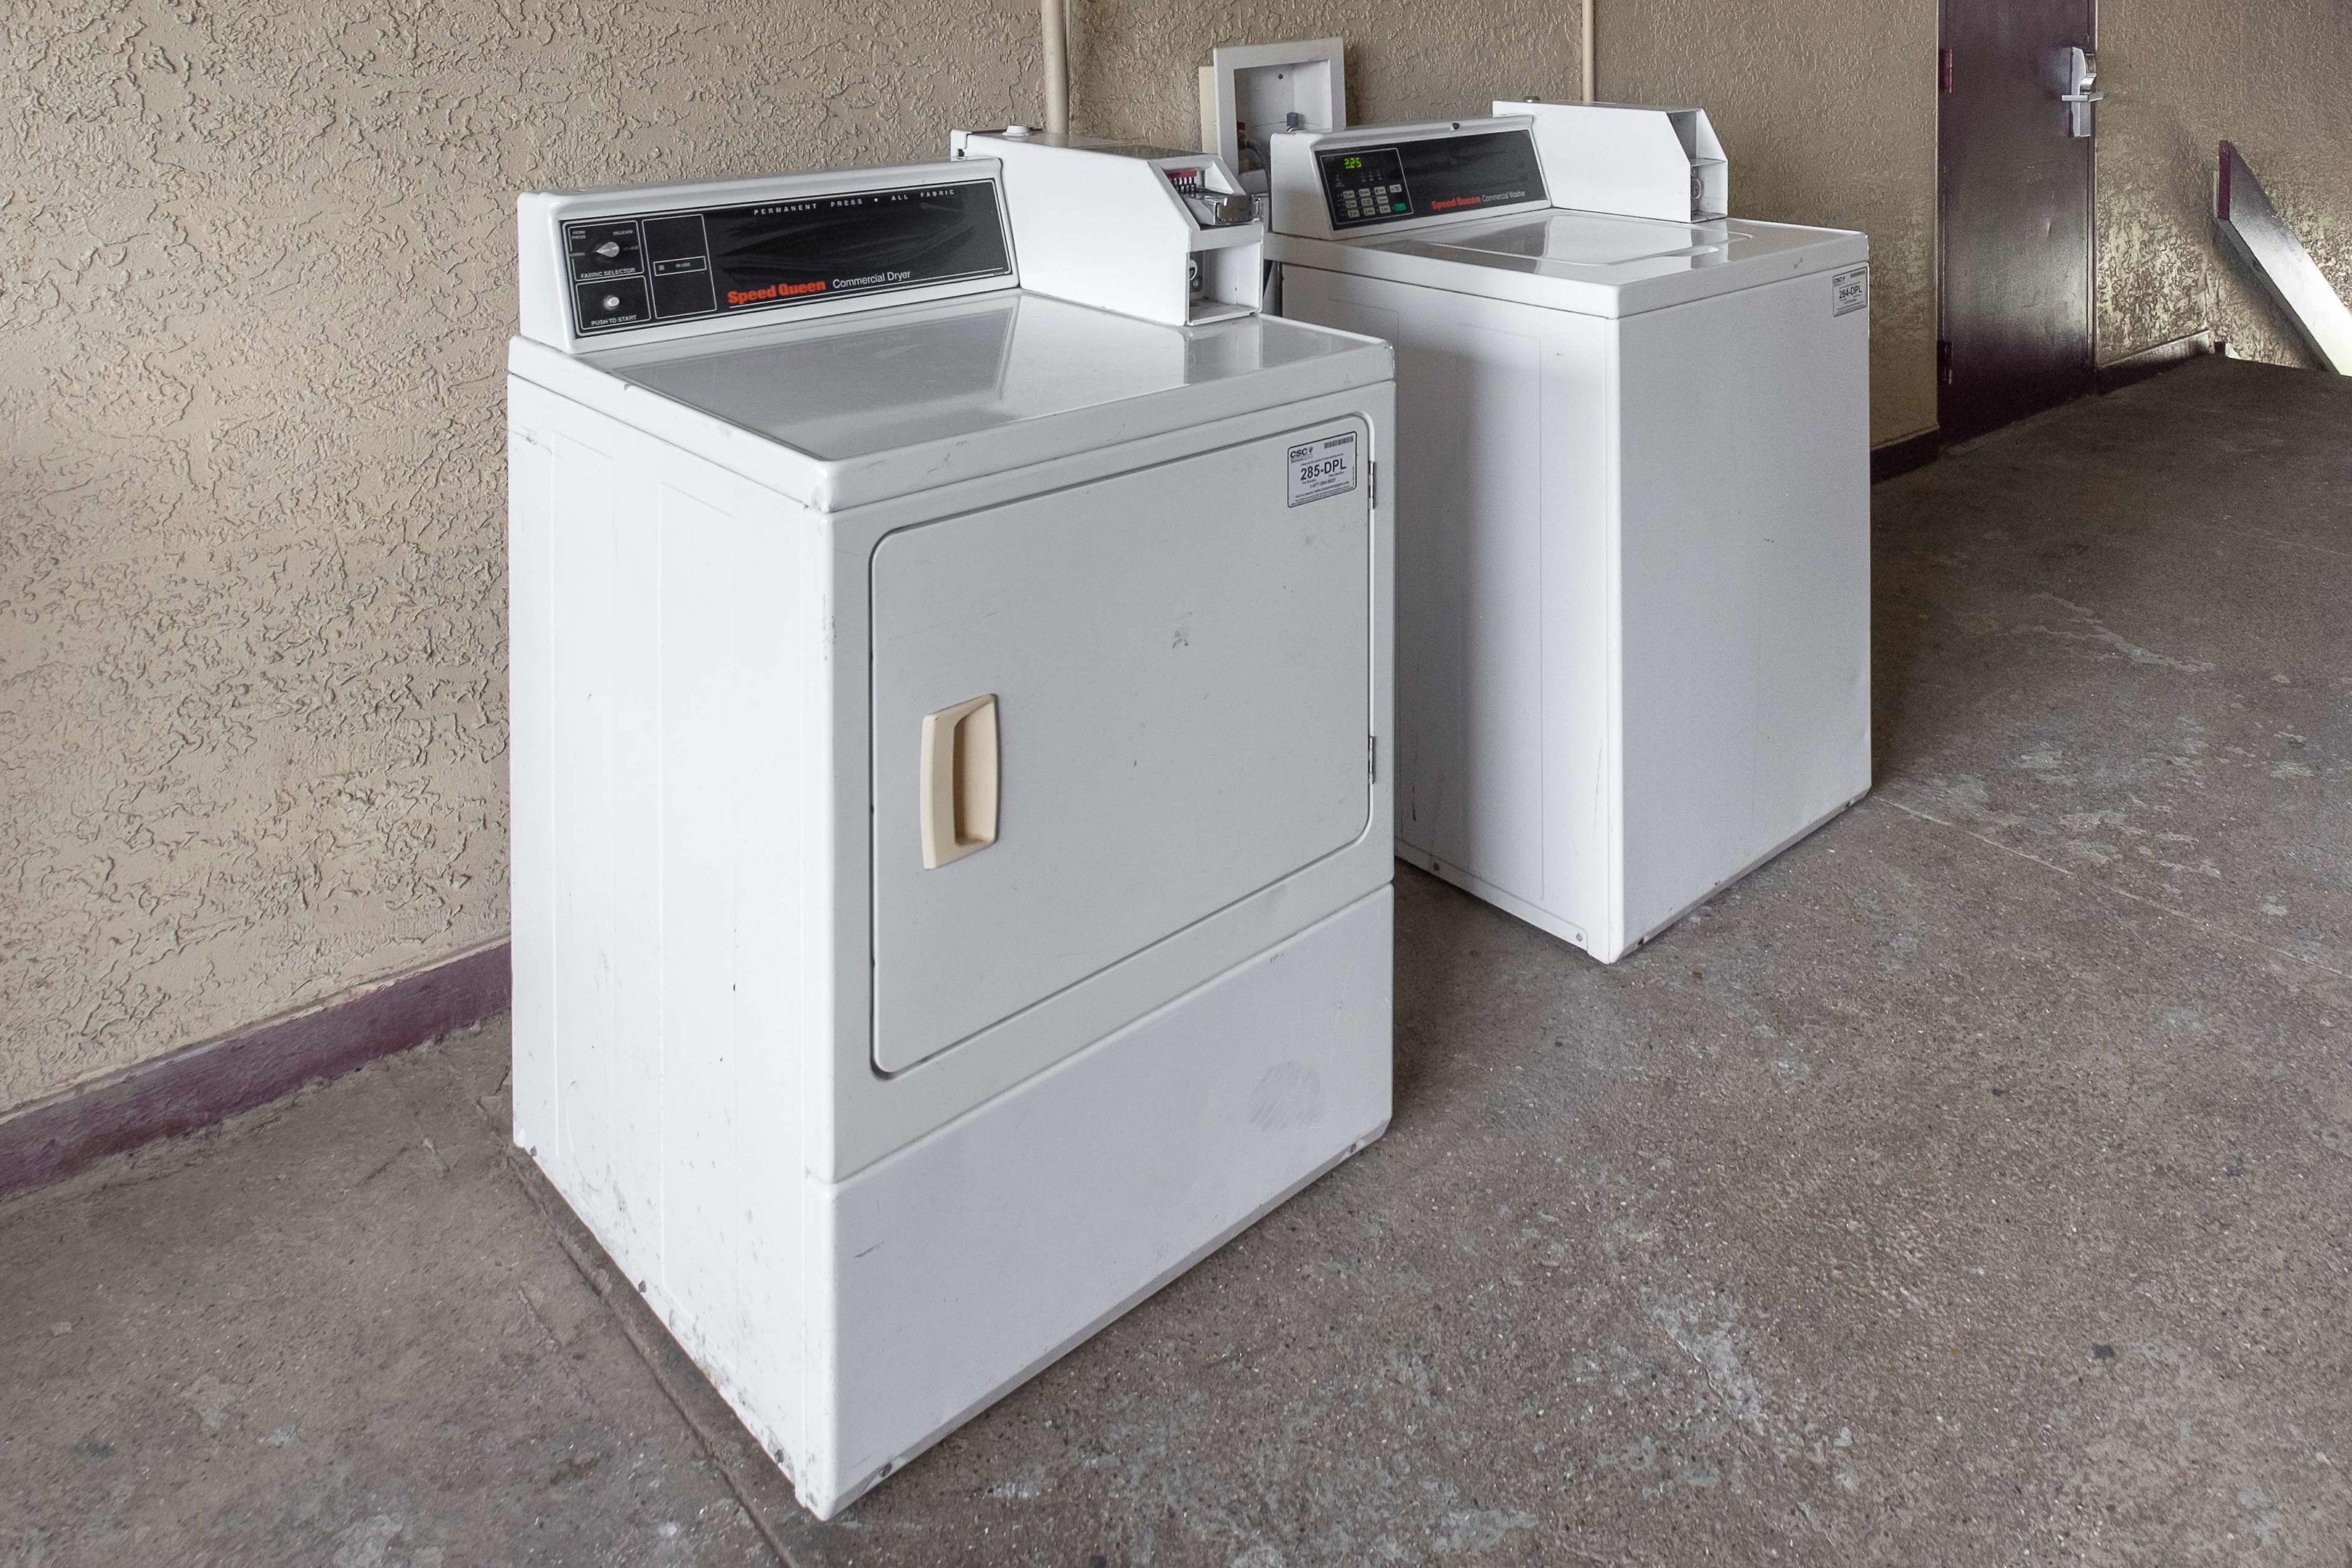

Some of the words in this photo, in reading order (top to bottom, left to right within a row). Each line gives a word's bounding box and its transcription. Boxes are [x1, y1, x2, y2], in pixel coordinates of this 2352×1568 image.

[754, 203, 817, 216] PERMANENT
[830, 198, 862, 208] PRESS
[920, 189, 955, 198] FABRIC
[1431, 197, 1456, 211] Speed
[1456, 196, 1481, 206] Queen
[603, 267, 636, 277] SELECTOR
[727, 285, 777, 305] Speed
[778, 280, 826, 296] Queen
[833, 272, 886, 289] Commercial
[887, 270, 912, 282] Dryer
[1290, 448, 1308, 459] CSC
[1300, 457, 1347, 481] 285-DPL
